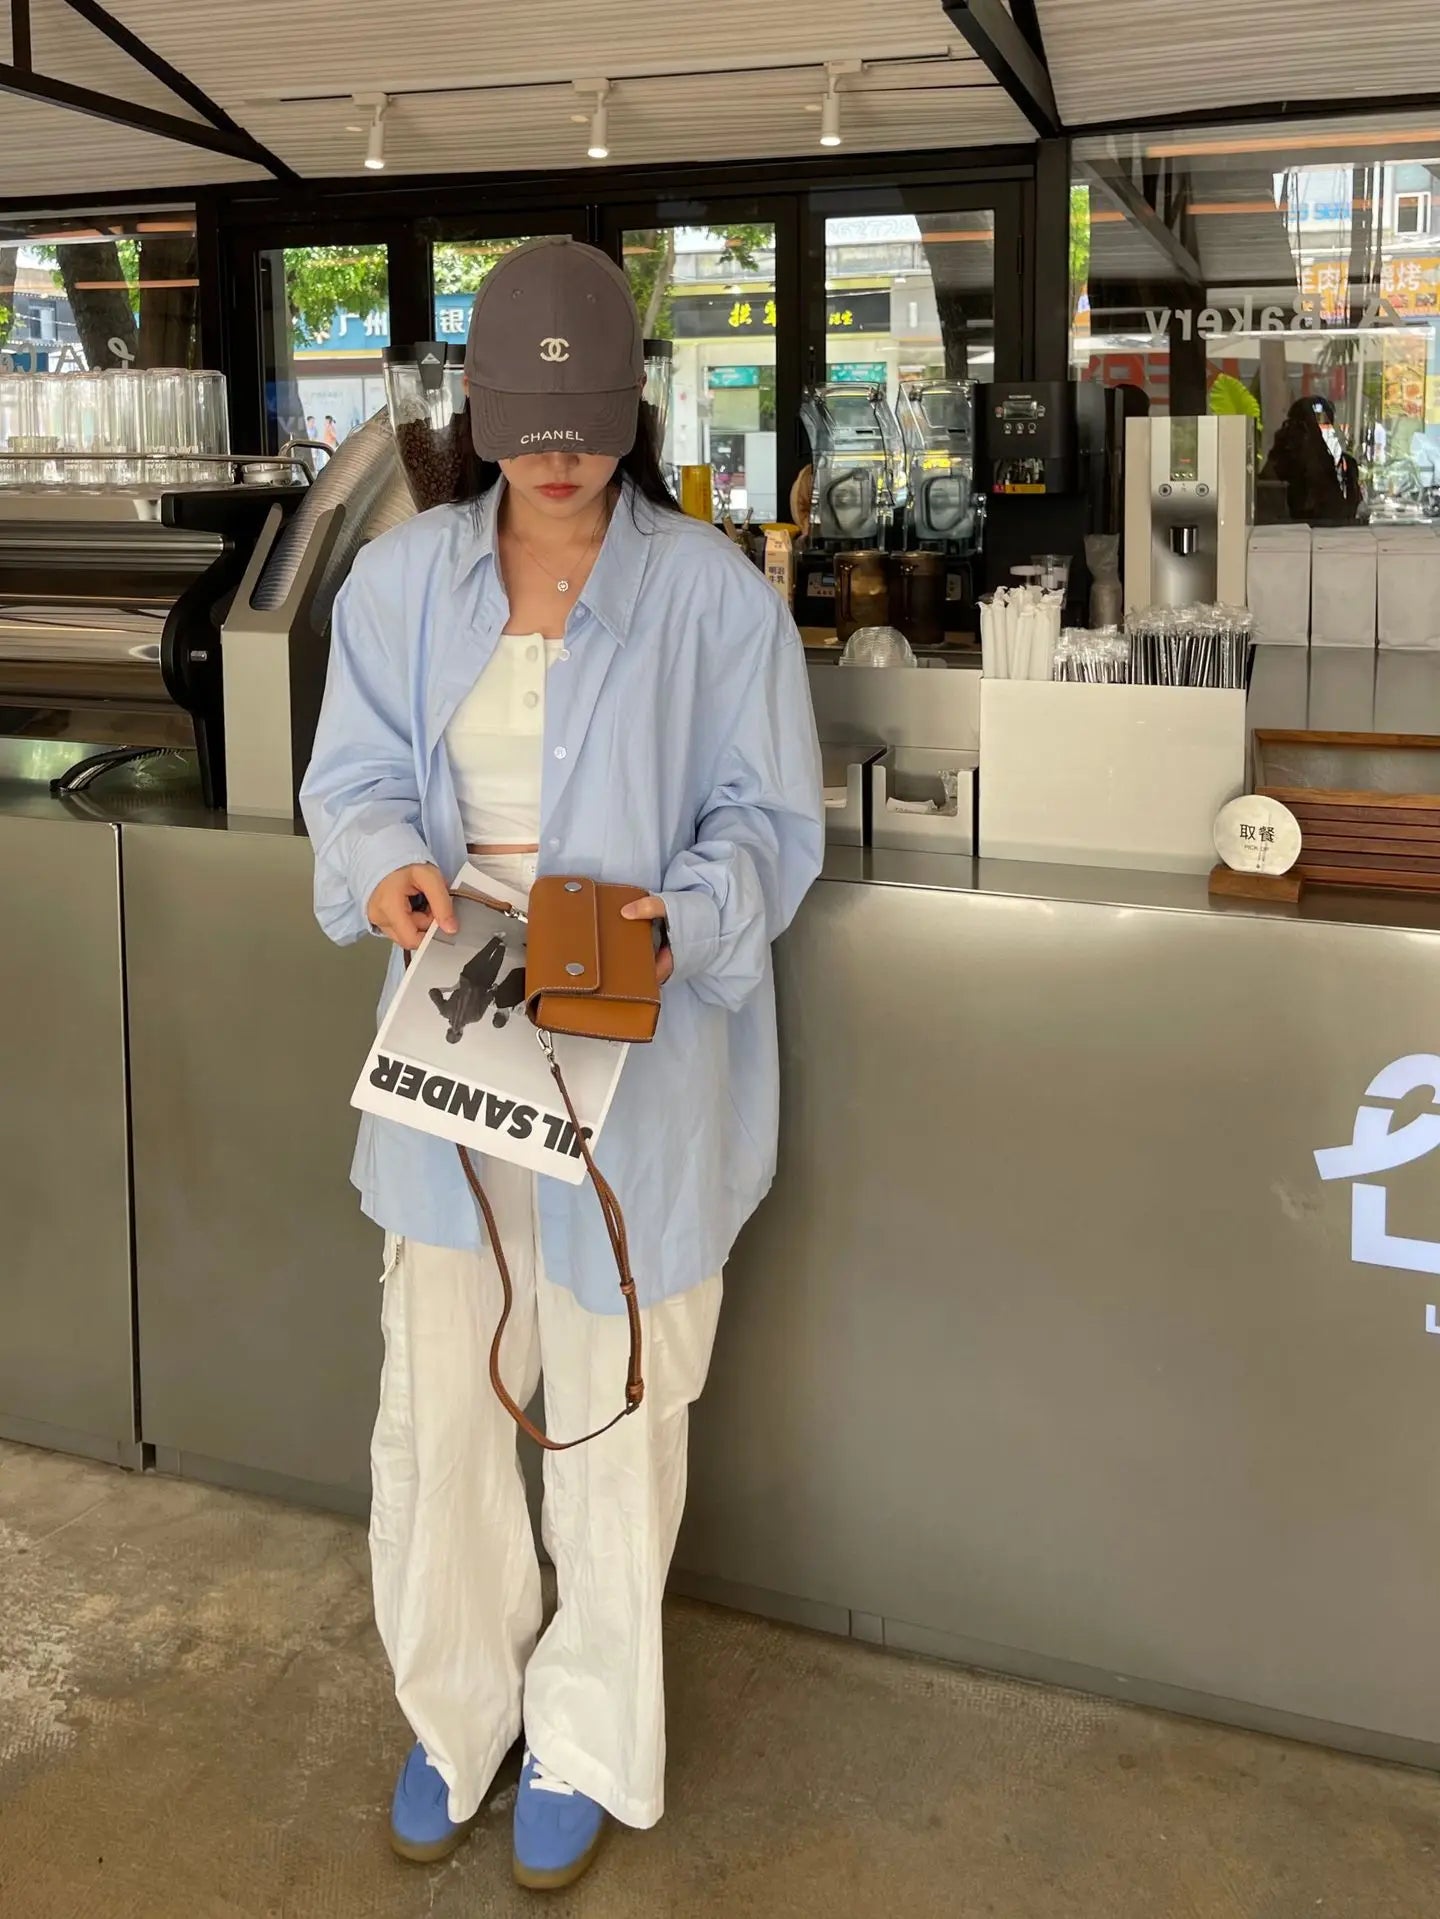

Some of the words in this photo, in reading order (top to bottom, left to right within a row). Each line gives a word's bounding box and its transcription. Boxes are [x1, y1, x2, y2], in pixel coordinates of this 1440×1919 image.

[520, 430, 585, 444] CHANEL
[1240, 824, 1275, 843] 取餐
[369, 1054, 540, 1139] SANDER
